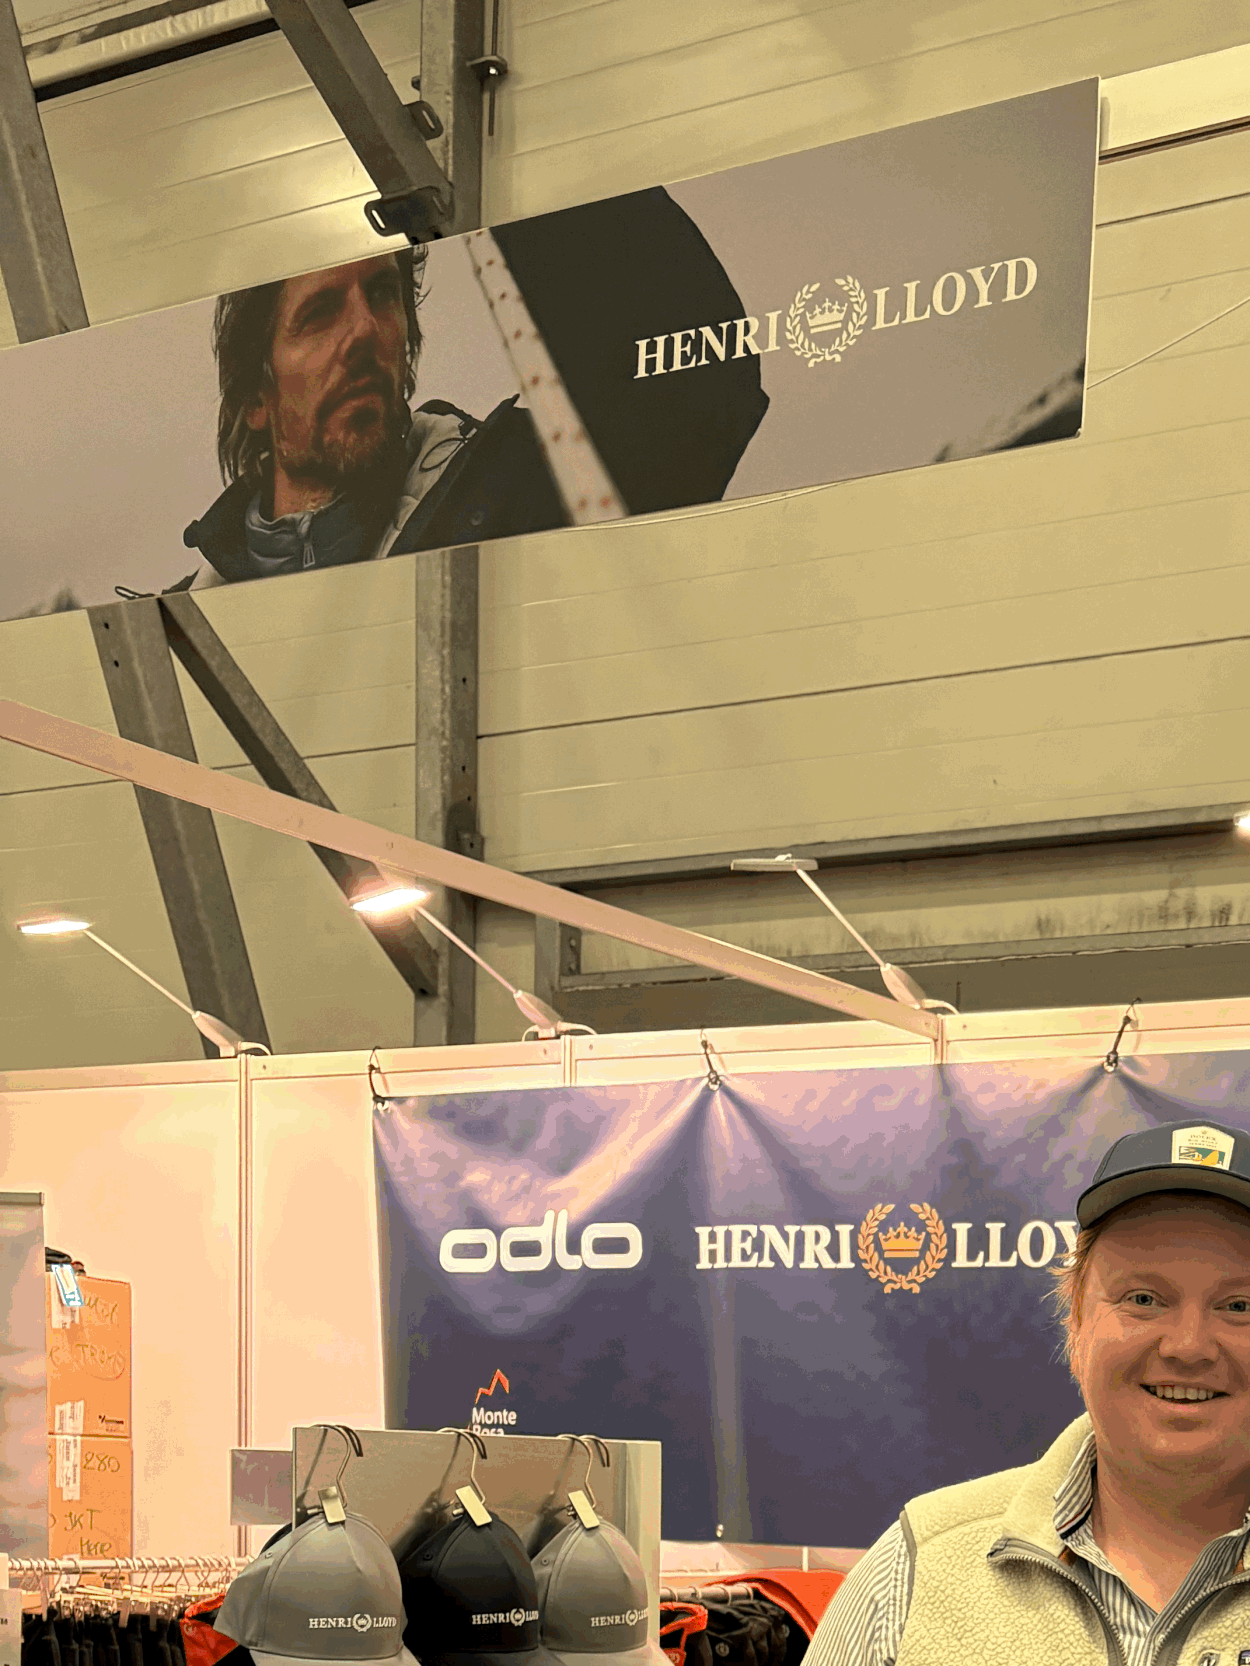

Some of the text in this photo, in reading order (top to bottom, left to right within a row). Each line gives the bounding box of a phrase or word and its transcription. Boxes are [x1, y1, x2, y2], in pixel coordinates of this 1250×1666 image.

[633, 256, 1039, 379] HENRI LLOYD
[438, 1208, 643, 1273] odlo
[695, 1223, 855, 1270] HENRI
[951, 1219, 1079, 1269] LLOY
[472, 1407, 517, 1425] Monte
[309, 1616, 397, 1629] HENRI LLOYD
[471, 1612, 510, 1625] HENRI
[591, 1615, 626, 1628] HENRI
